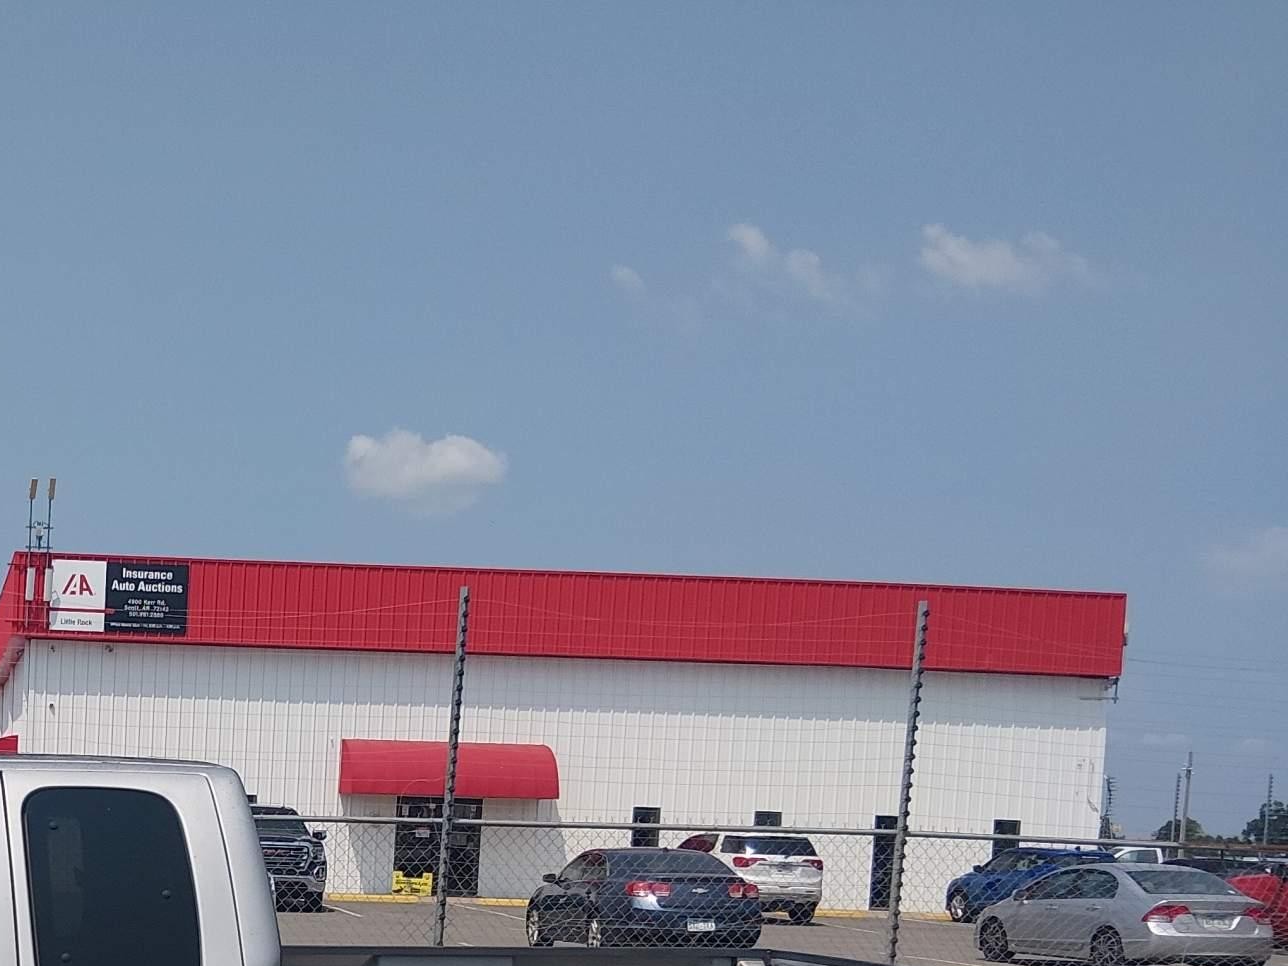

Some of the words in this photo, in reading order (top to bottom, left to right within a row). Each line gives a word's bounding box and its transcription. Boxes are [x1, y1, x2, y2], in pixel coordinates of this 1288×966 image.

[122, 568, 173, 580] Insurance
[112, 580, 136, 592] Auto
[138, 580, 183, 593] Auctions
[60, 617, 75, 625] Little
[77, 618, 92, 626] Rock
